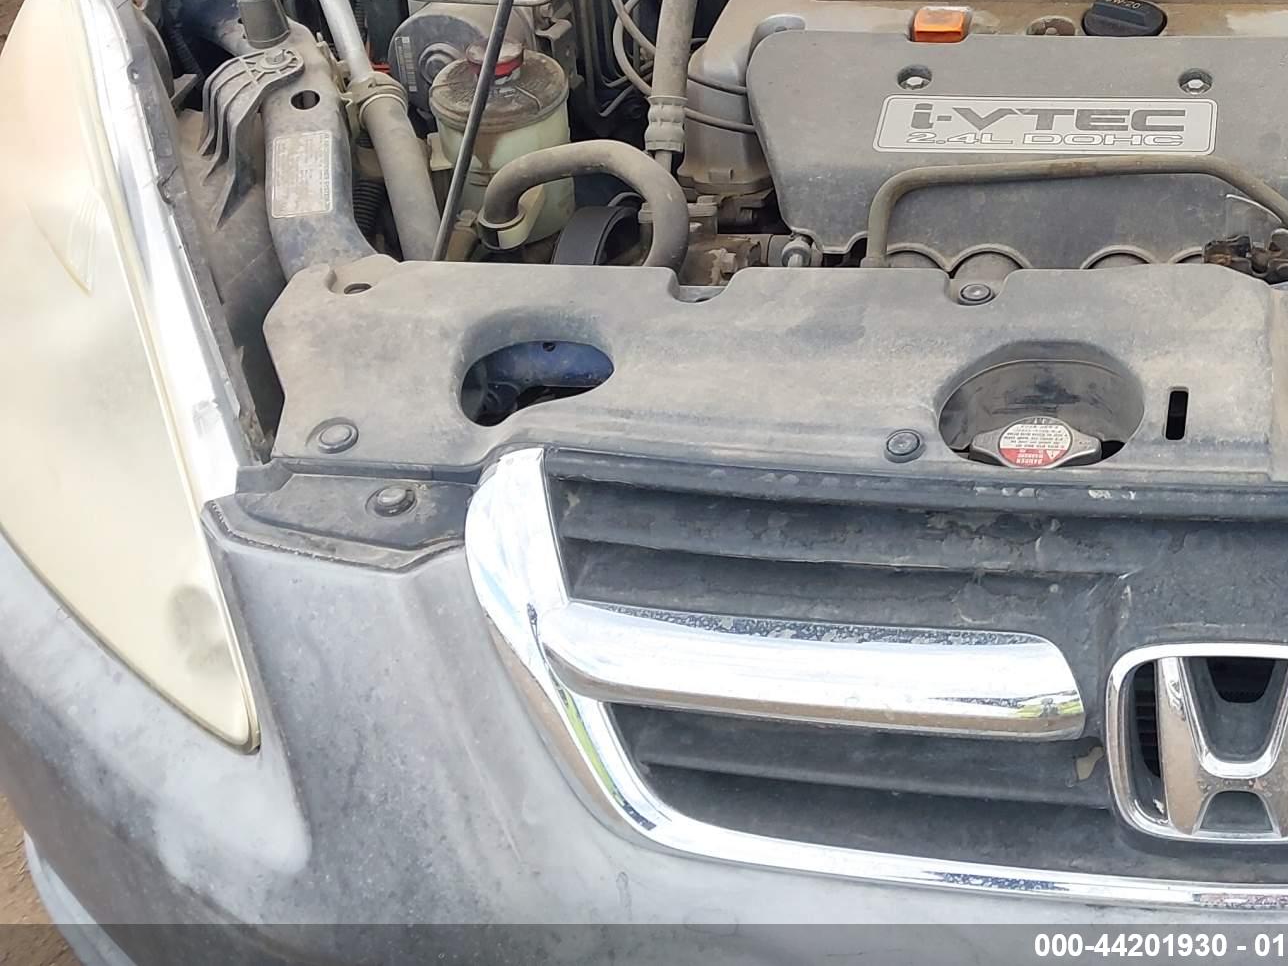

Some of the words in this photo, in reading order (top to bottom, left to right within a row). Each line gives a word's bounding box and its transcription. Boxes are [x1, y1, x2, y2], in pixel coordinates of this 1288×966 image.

[910, 103, 1186, 132] i-VTEC
[906, 132, 1013, 145] 2.4L
[1022, 132, 1184, 147] DOHC
